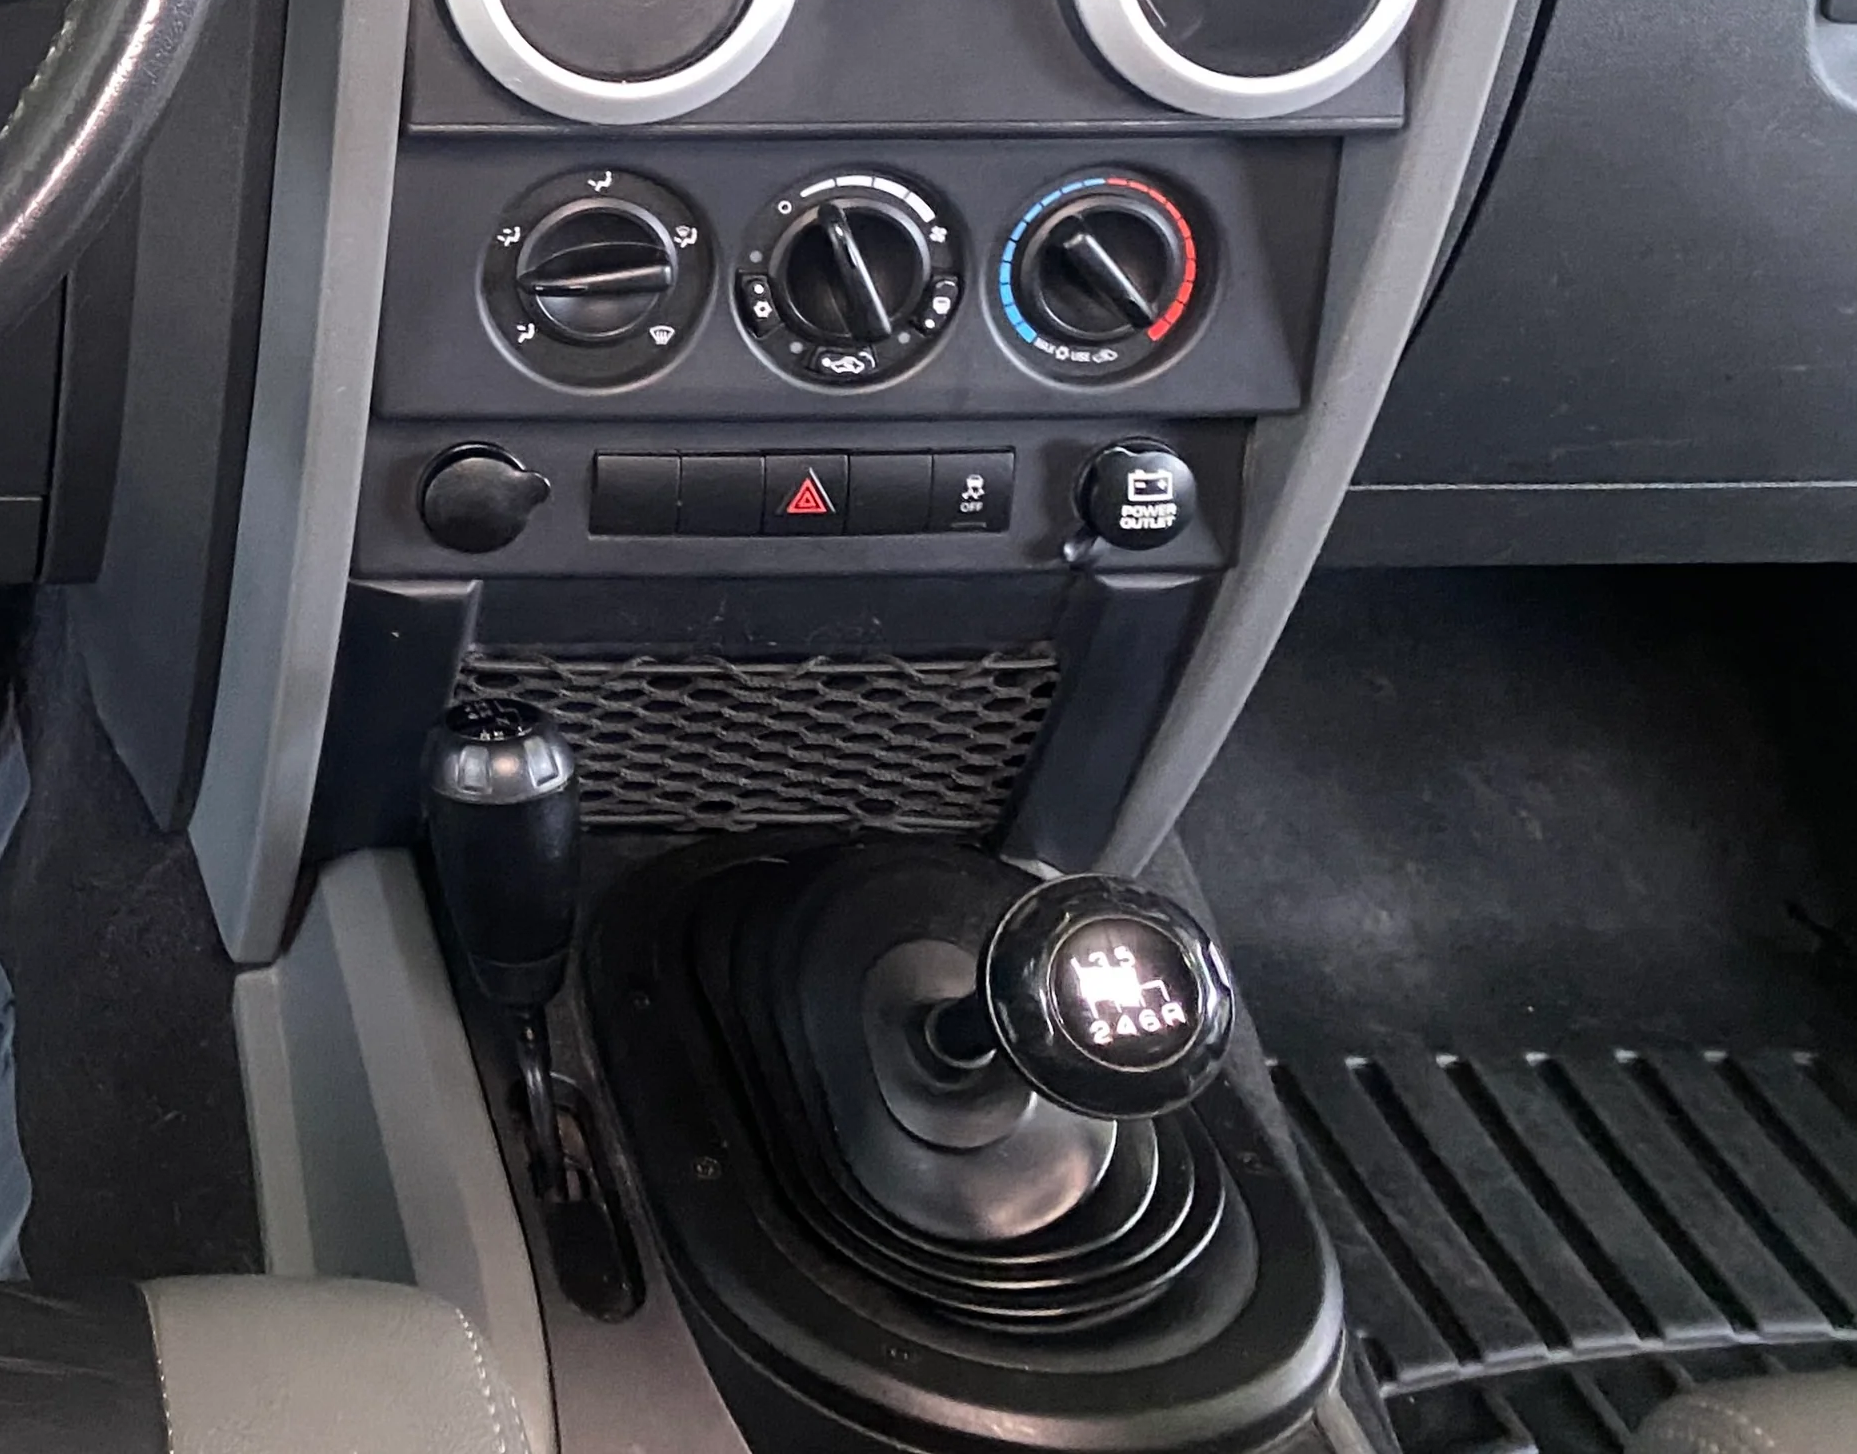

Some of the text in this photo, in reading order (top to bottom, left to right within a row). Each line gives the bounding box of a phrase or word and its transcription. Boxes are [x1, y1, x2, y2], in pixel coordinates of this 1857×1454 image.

[960, 501, 984, 513] OFF
[1121, 503, 1177, 518] POWER
[1119, 516, 1176, 529] OUTLET
[1090, 1020, 1113, 1045] 2
[1139, 1009, 1161, 1033] 6
